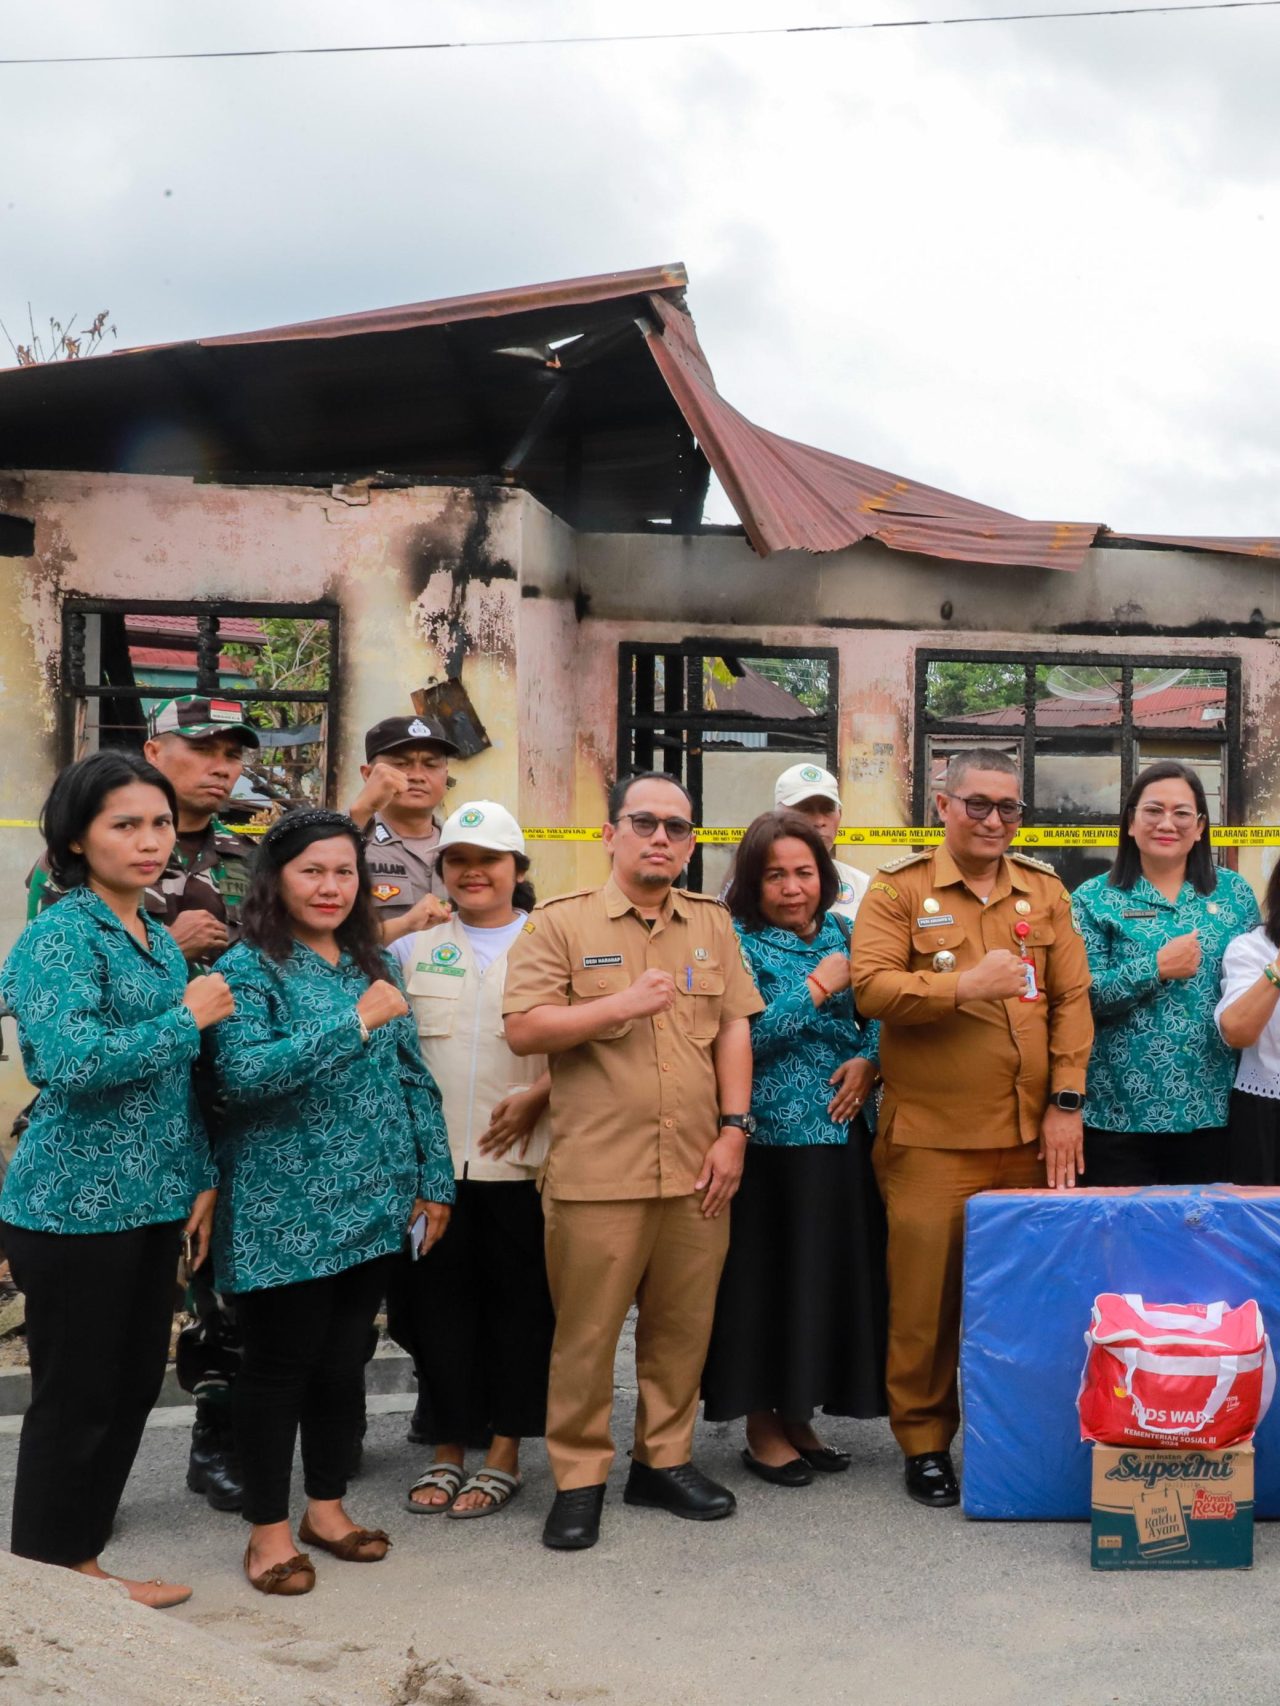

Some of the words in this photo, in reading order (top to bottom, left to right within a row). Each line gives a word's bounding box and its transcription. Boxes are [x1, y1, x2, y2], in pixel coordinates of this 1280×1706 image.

[1044, 830, 1080, 838] DILARANG
[1082, 830, 1118, 838] MELINTAS
[1213, 829, 1248, 838] DILARANG
[1131, 1403, 1167, 1421] KDS
[1124, 1427, 1179, 1441] KEMENTERIAN
[1180, 1436, 1207, 1444] SOSIAL
[1193, 1500, 1234, 1515] Resep
[1145, 1513, 1177, 1529] Kaldu
[1148, 1525, 1180, 1539] Ayam
